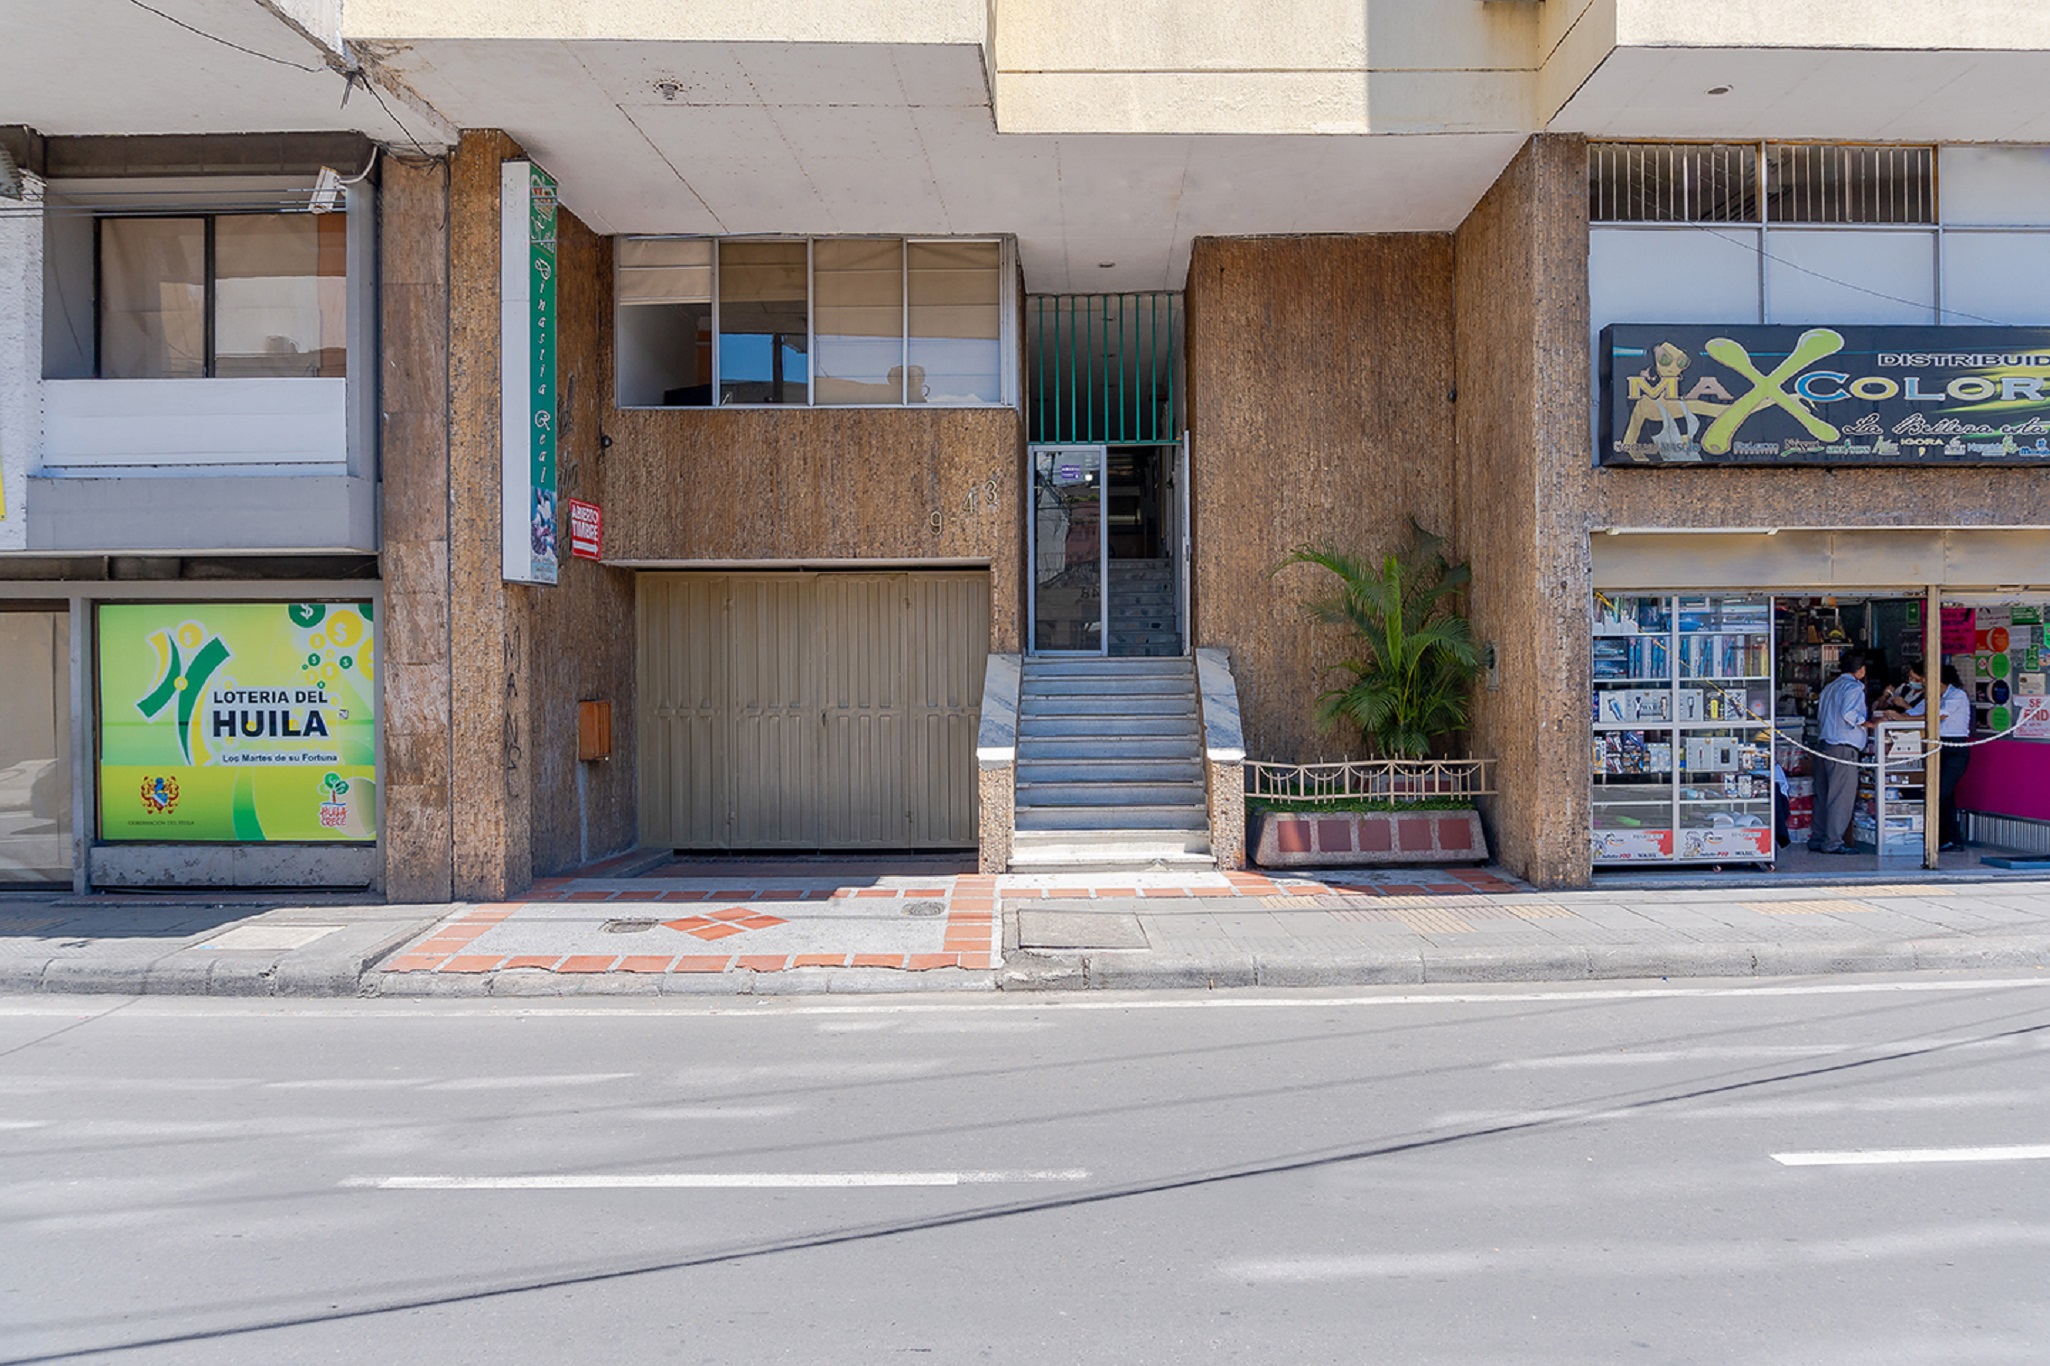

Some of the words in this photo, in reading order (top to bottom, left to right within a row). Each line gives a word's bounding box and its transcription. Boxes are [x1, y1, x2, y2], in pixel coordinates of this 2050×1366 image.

[534, 257, 551, 396] Dinastia
[534, 409, 551, 484] Real
[572, 520, 599, 541] TIMBRE
[213, 691, 290, 704] LOTERIA
[295, 691, 328, 703] DEL
[213, 710, 328, 737] HUILA
[242, 754, 272, 762] Martes
[302, 753, 338, 762] Fortuna
